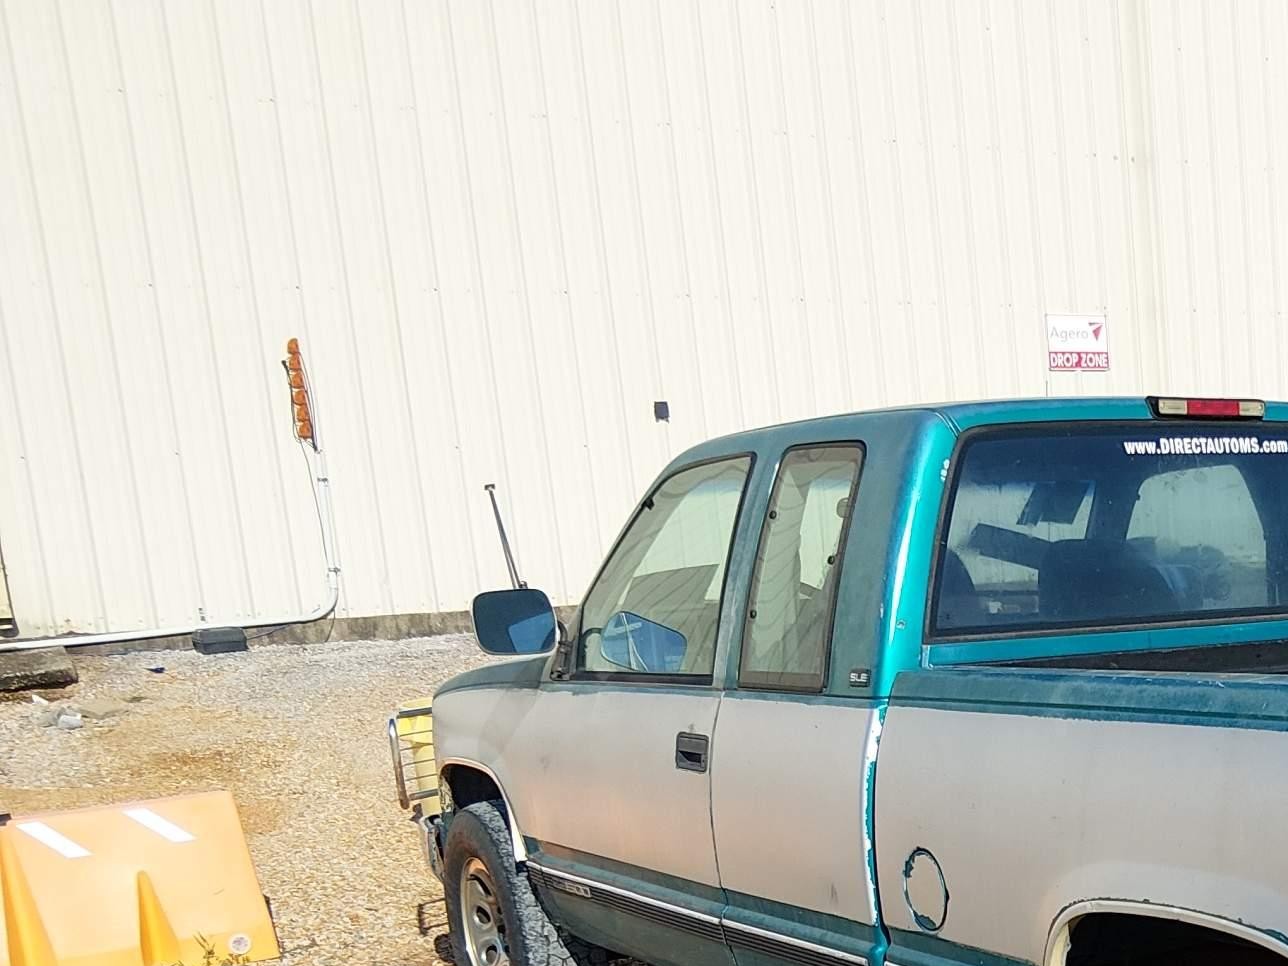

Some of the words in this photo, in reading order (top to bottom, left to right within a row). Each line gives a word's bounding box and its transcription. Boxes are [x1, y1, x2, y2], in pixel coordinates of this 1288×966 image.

[1050, 325, 1089, 342] Agero
[1050, 353, 1079, 368] DROP
[1080, 353, 1109, 368] ZONE
[1123, 437, 1288, 455] www.DIRECTAUTOMS.com
[850, 673, 868, 682] SLE
